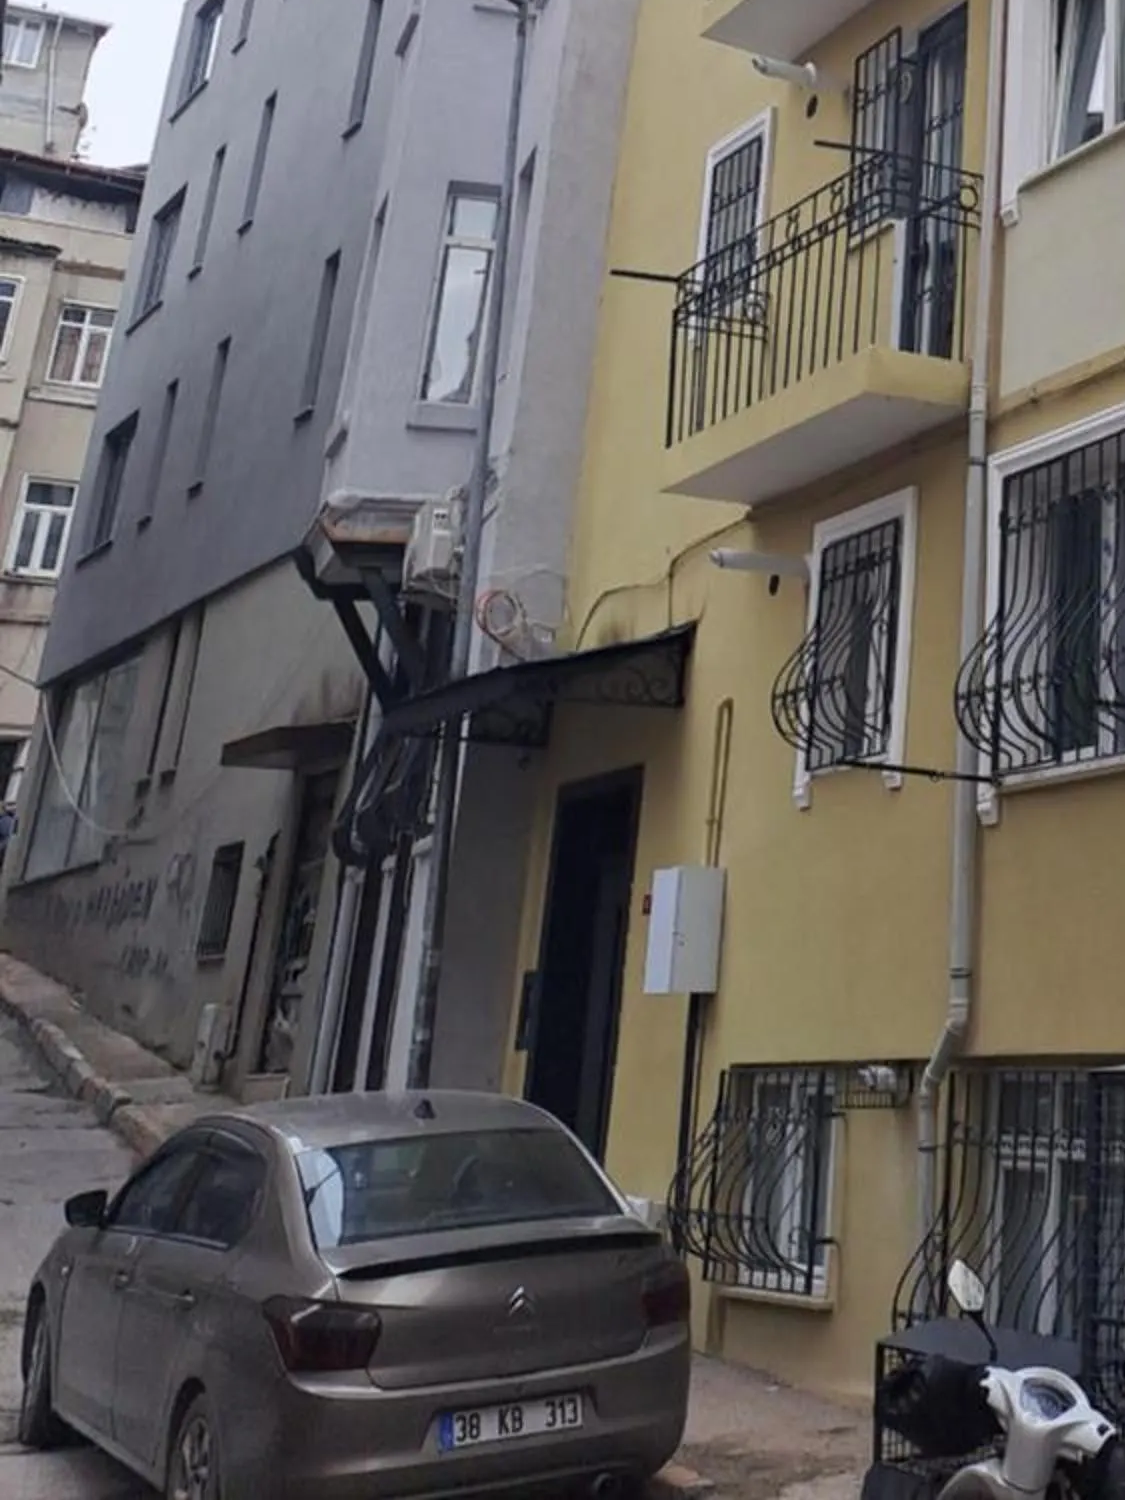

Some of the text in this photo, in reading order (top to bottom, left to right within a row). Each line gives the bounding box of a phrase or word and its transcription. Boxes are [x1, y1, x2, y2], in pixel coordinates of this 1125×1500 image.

[455, 1398, 578, 1442] 38 KB 313
